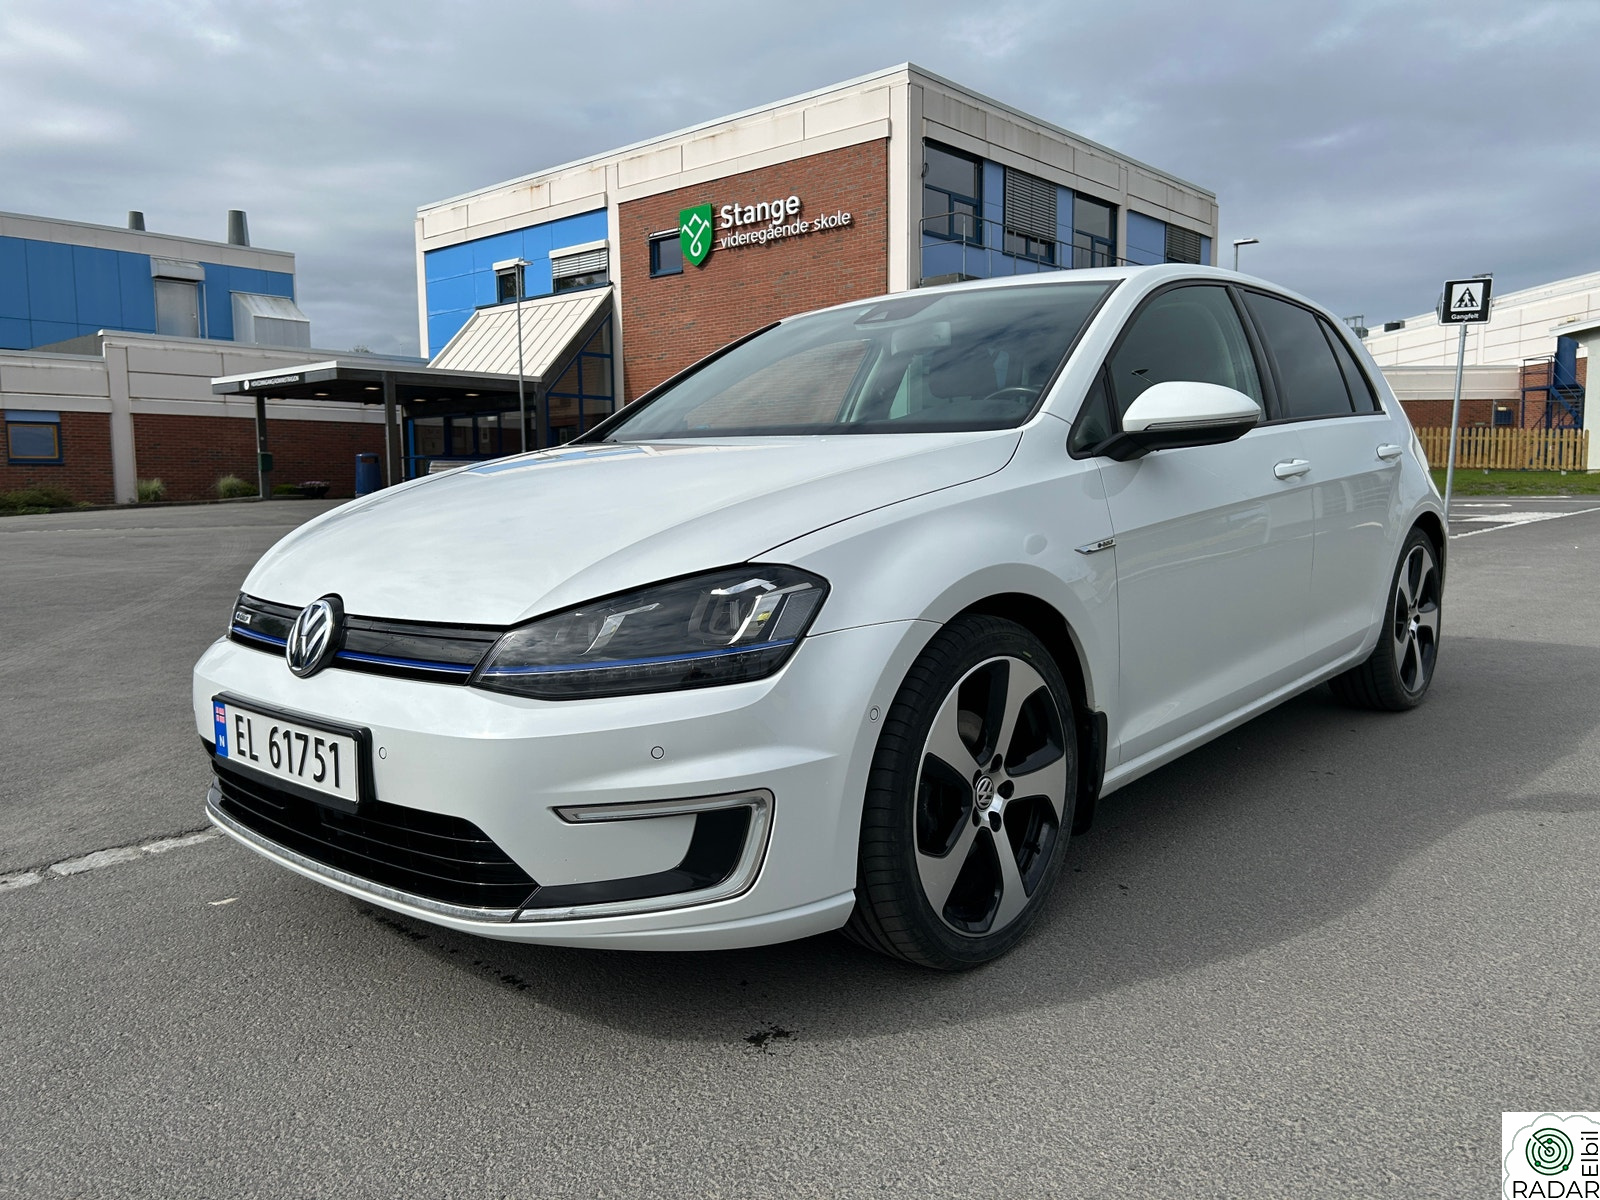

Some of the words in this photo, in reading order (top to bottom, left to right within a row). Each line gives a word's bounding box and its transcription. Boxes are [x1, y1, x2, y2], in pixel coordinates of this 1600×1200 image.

[720, 195, 800, 229] Stange
[720, 216, 809, 249] videregående
[813, 210, 851, 231] skole
[218, 734, 226, 748] N
[234, 713, 259, 762] EL
[268, 726, 340, 789] 61751
